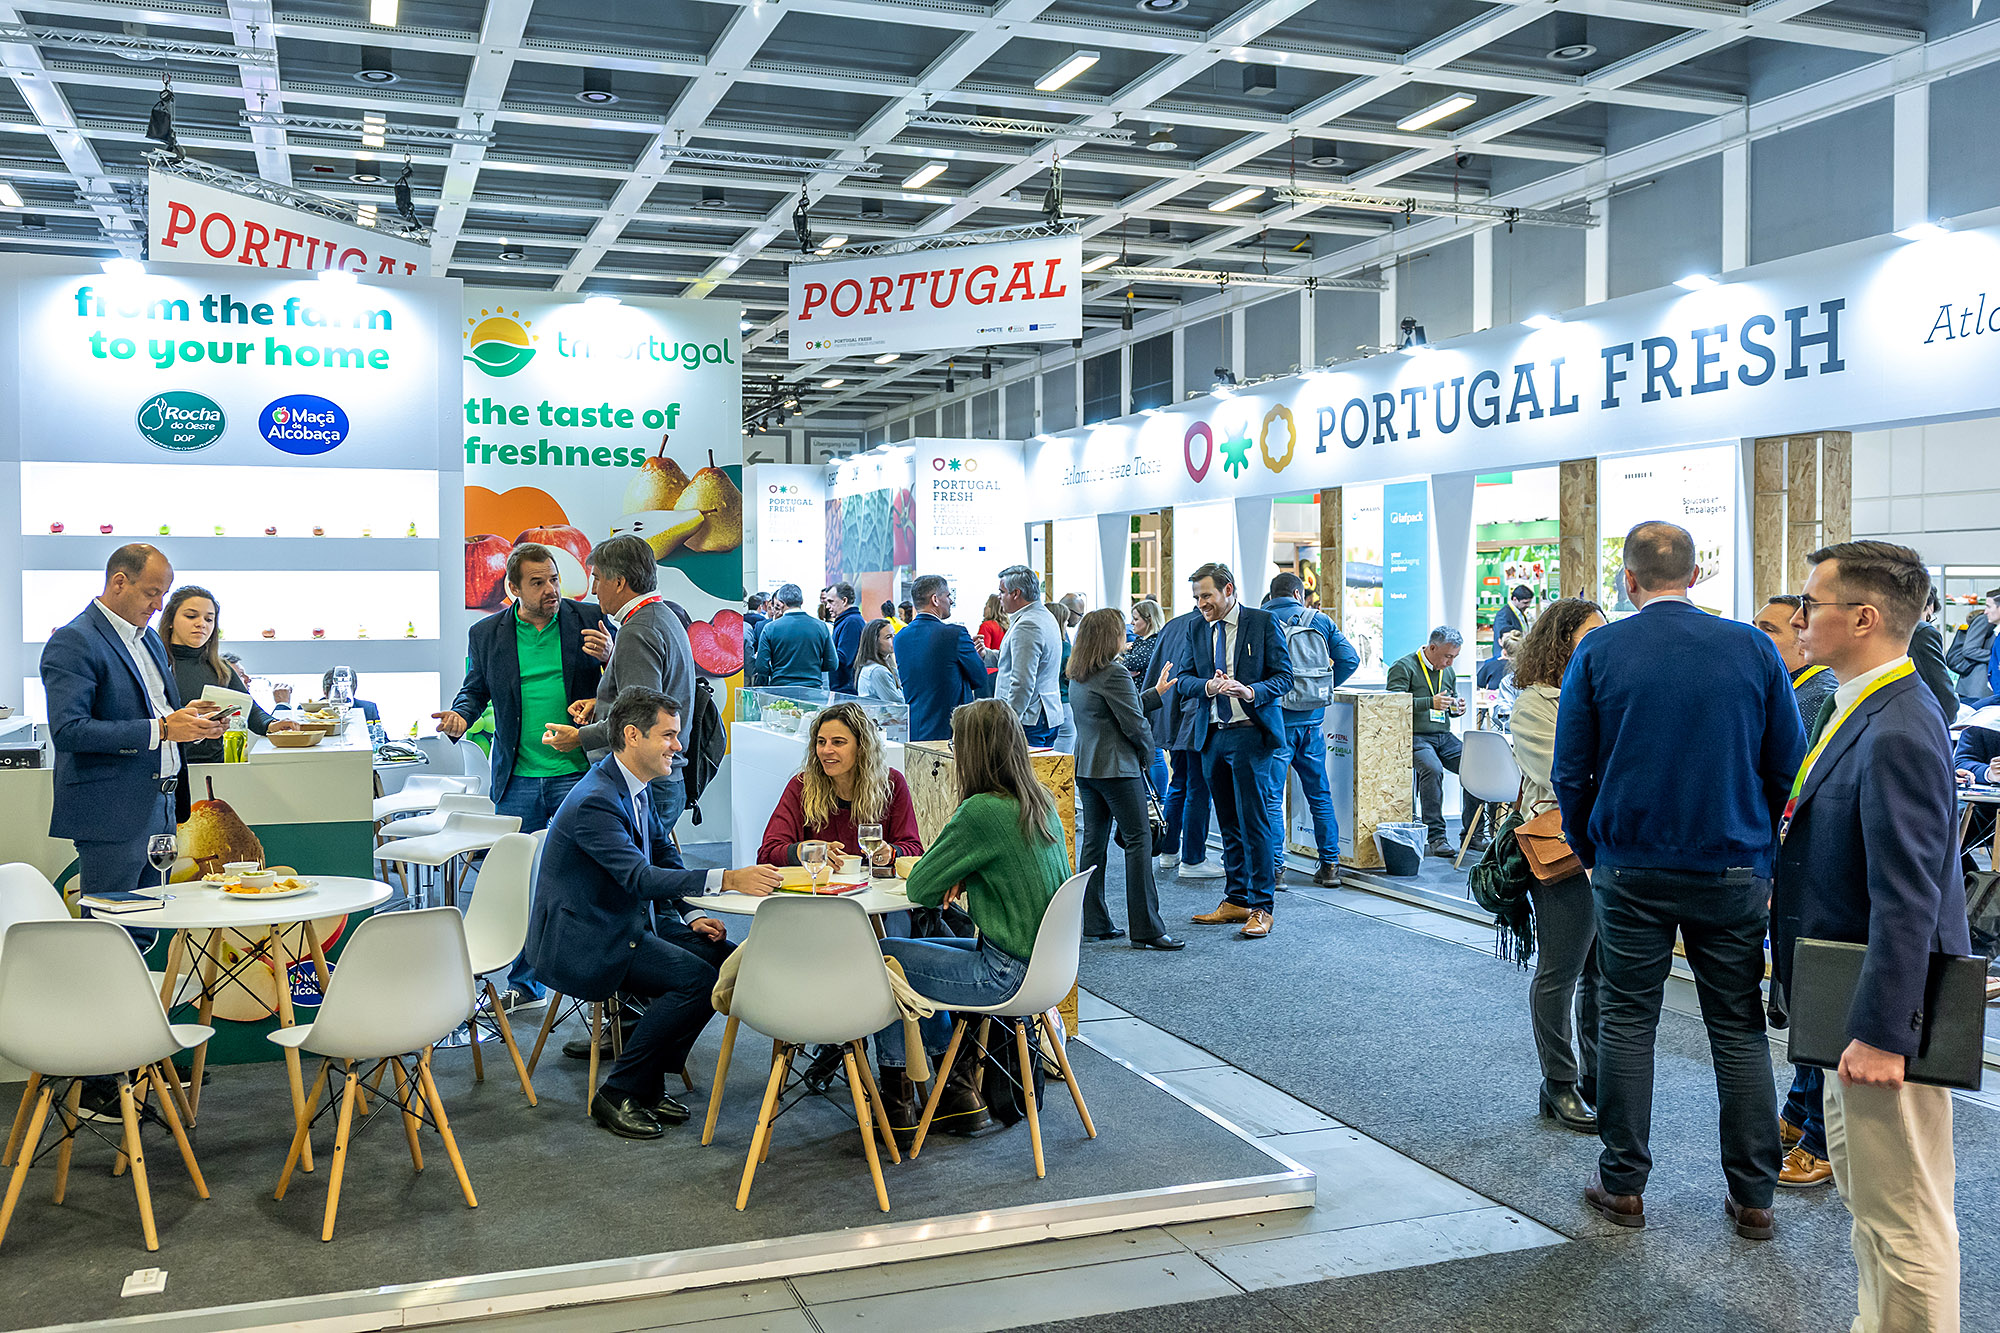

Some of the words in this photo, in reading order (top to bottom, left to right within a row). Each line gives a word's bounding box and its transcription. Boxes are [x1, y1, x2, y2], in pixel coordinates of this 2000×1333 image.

[798, 258, 1067, 321] PORTUGAL
[200, 294, 274, 325] the
[89, 330, 137, 360] to
[148, 336, 255, 369] your
[265, 337, 390, 370] home
[1316, 356, 1579, 455] PORTUGAL
[1601, 297, 1846, 410] FRESH
[165, 406, 220, 421] Rocha
[292, 408, 335, 427] Maçã
[464, 398, 530, 426] the
[537, 400, 634, 429] taste
[642, 403, 681, 430] of
[170, 421, 184, 430] do
[185, 421, 216, 430] Oeste
[267, 424, 340, 444] Alcobaça
[173, 434, 195, 442] DOP
[813, 440, 842, 448] Übergang
[464, 436, 646, 468] freshness
[933, 479, 1001, 490] PORTUGAL
[769, 498, 813, 506] PORTUGAL
[933, 491, 973, 501] FRESH
